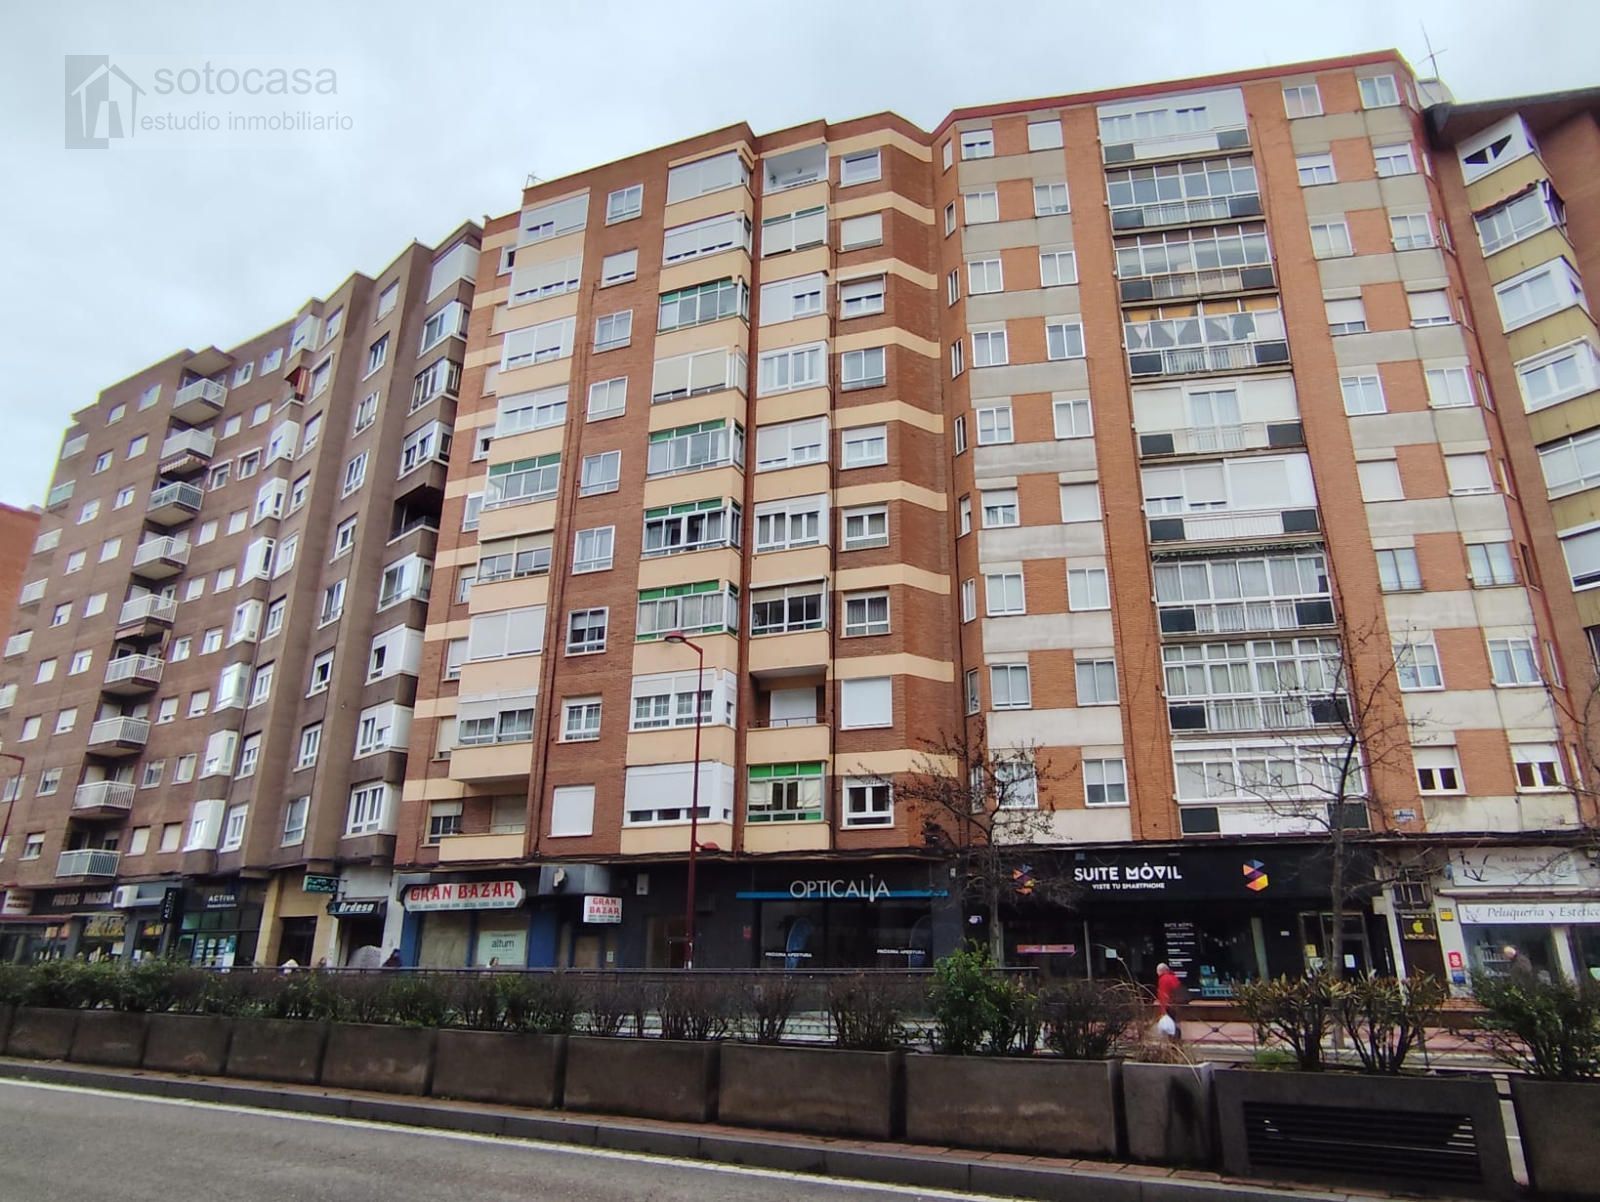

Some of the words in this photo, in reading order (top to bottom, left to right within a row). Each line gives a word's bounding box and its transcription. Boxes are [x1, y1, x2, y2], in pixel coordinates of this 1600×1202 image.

[1074, 867, 1120, 881] SUITE
[789, 876, 890, 901] OPTICALIA
[1122, 882, 1165, 890] SMARTPHONE
[410, 885, 452, 902] GRAN
[457, 882, 515, 900] BAZAR
[208, 894, 236, 903] ACTIVA
[592, 897, 617, 906] GRAN
[589, 906, 620, 915] BAZAR
